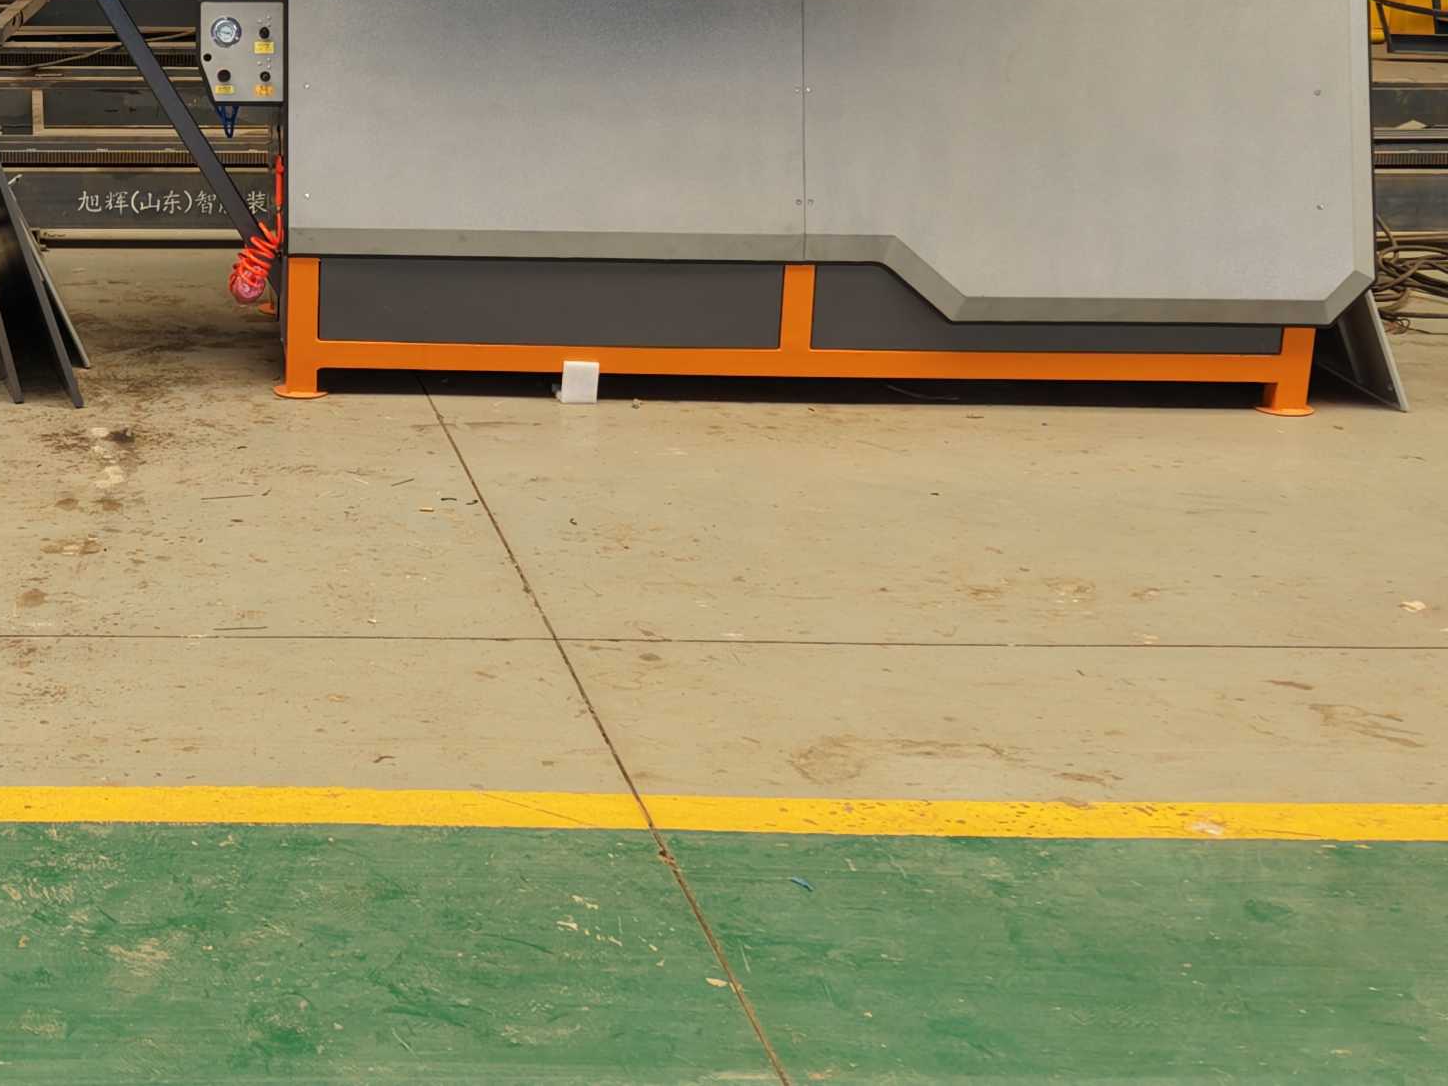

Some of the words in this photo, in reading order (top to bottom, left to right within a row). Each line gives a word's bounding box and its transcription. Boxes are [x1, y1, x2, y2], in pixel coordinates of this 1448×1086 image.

[77, 189, 269, 215] 旭辉(山东)智装
